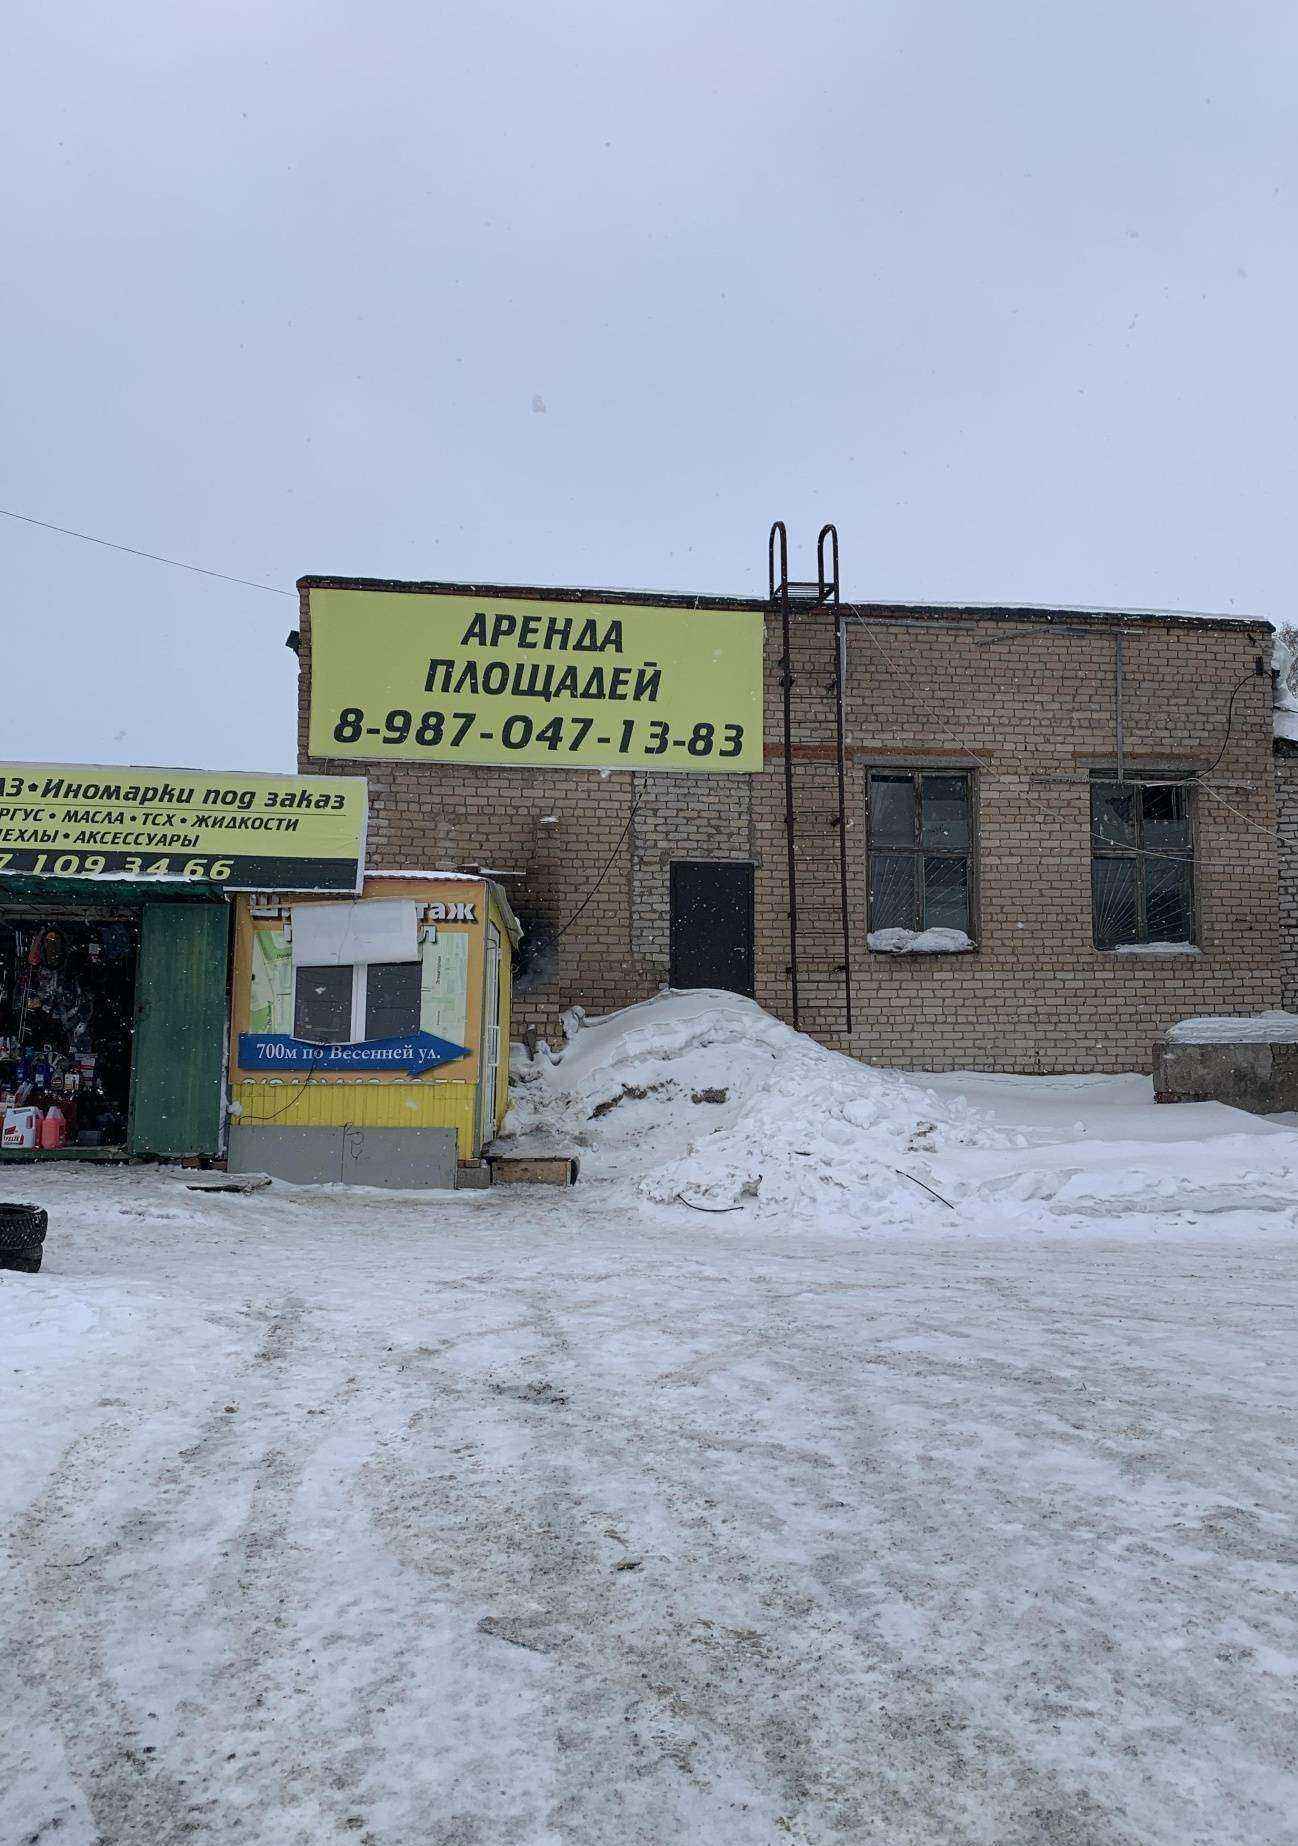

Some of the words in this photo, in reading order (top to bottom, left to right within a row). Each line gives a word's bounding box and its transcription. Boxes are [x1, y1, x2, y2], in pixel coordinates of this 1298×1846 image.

[460, 612, 624, 653] АРЕНДА
[424, 658, 663, 702] ПЛОЩАДЕЙ
[333, 707, 745, 758] 8-987-047-13-83
[40, 778, 195, 806] Иномарки
[202, 788, 256, 810] под
[264, 789, 346, 810] заказ
[61, 809, 124, 824] МАСЛА
[141, 812, 175, 827] ТСХ
[190, 813, 299, 832] ЖИДКОСТИ
[0, 828, 59, 843] ЕХЛЫ
[73, 831, 200, 847] АКСЕССУАРЫ
[256, 1043, 297, 1059] 700м
[302, 1049, 324, 1060] по
[329, 1044, 414, 1060] Весенней
[420, 1050, 441, 1063] ул.
